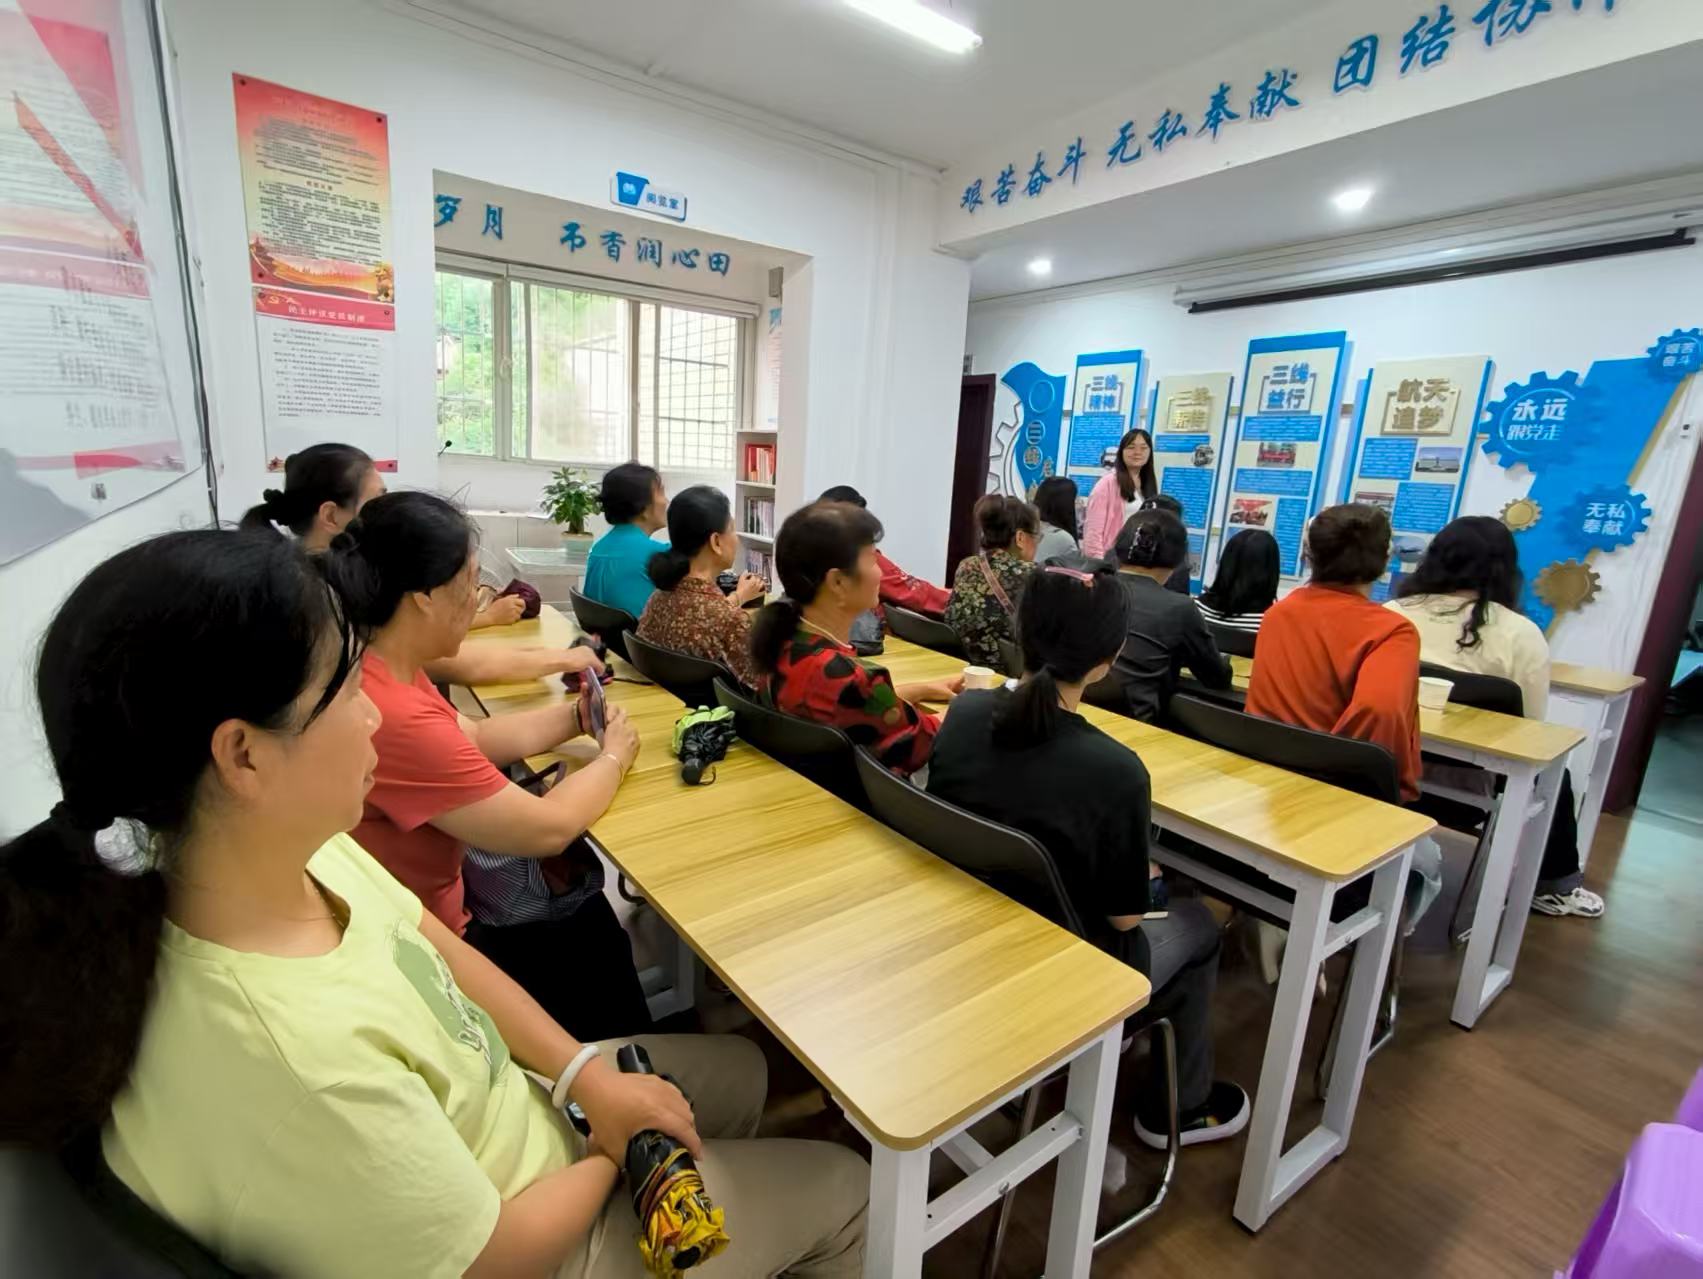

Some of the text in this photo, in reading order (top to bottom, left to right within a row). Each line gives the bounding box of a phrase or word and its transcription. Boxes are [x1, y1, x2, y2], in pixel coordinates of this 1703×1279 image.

[959, 0, 1616, 214] 艰苦奋斗 无私奉献 团结协
[1397, 378, 1450, 402] 航天
[1511, 398, 1568, 421] 永远
[1506, 424, 1561, 441] 跟党走
[1585, 502, 1626, 518] 无私
[1582, 519, 1624, 536] 奉献
